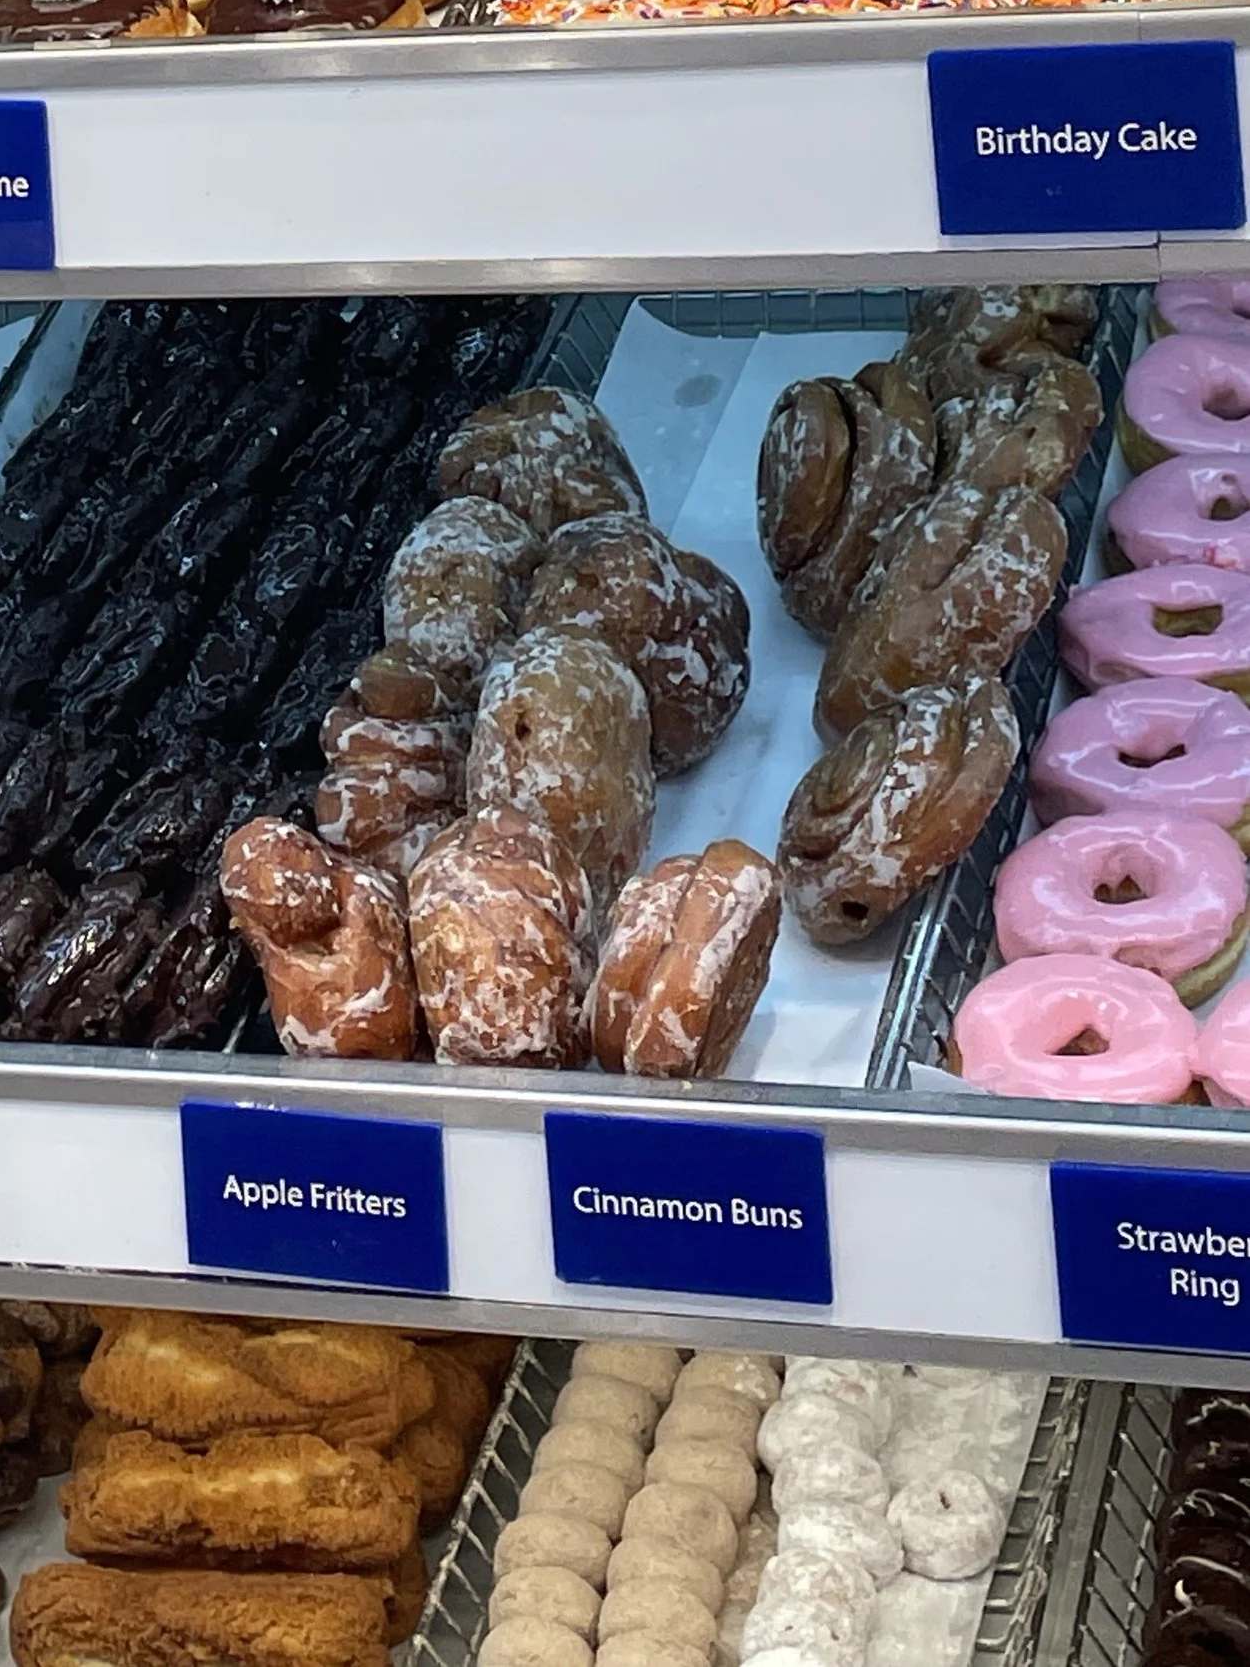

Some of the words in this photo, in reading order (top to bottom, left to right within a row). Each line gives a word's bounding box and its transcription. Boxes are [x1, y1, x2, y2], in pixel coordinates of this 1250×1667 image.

[976, 123, 1110, 160] Birthday
[1117, 121, 1198, 152] Cake
[222, 1174, 304, 1210] Apple
[310, 1182, 407, 1218] Fritters
[573, 1186, 723, 1223] Cinnamon
[730, 1197, 803, 1230] Buns
[1170, 1268, 1240, 1307] Ring
